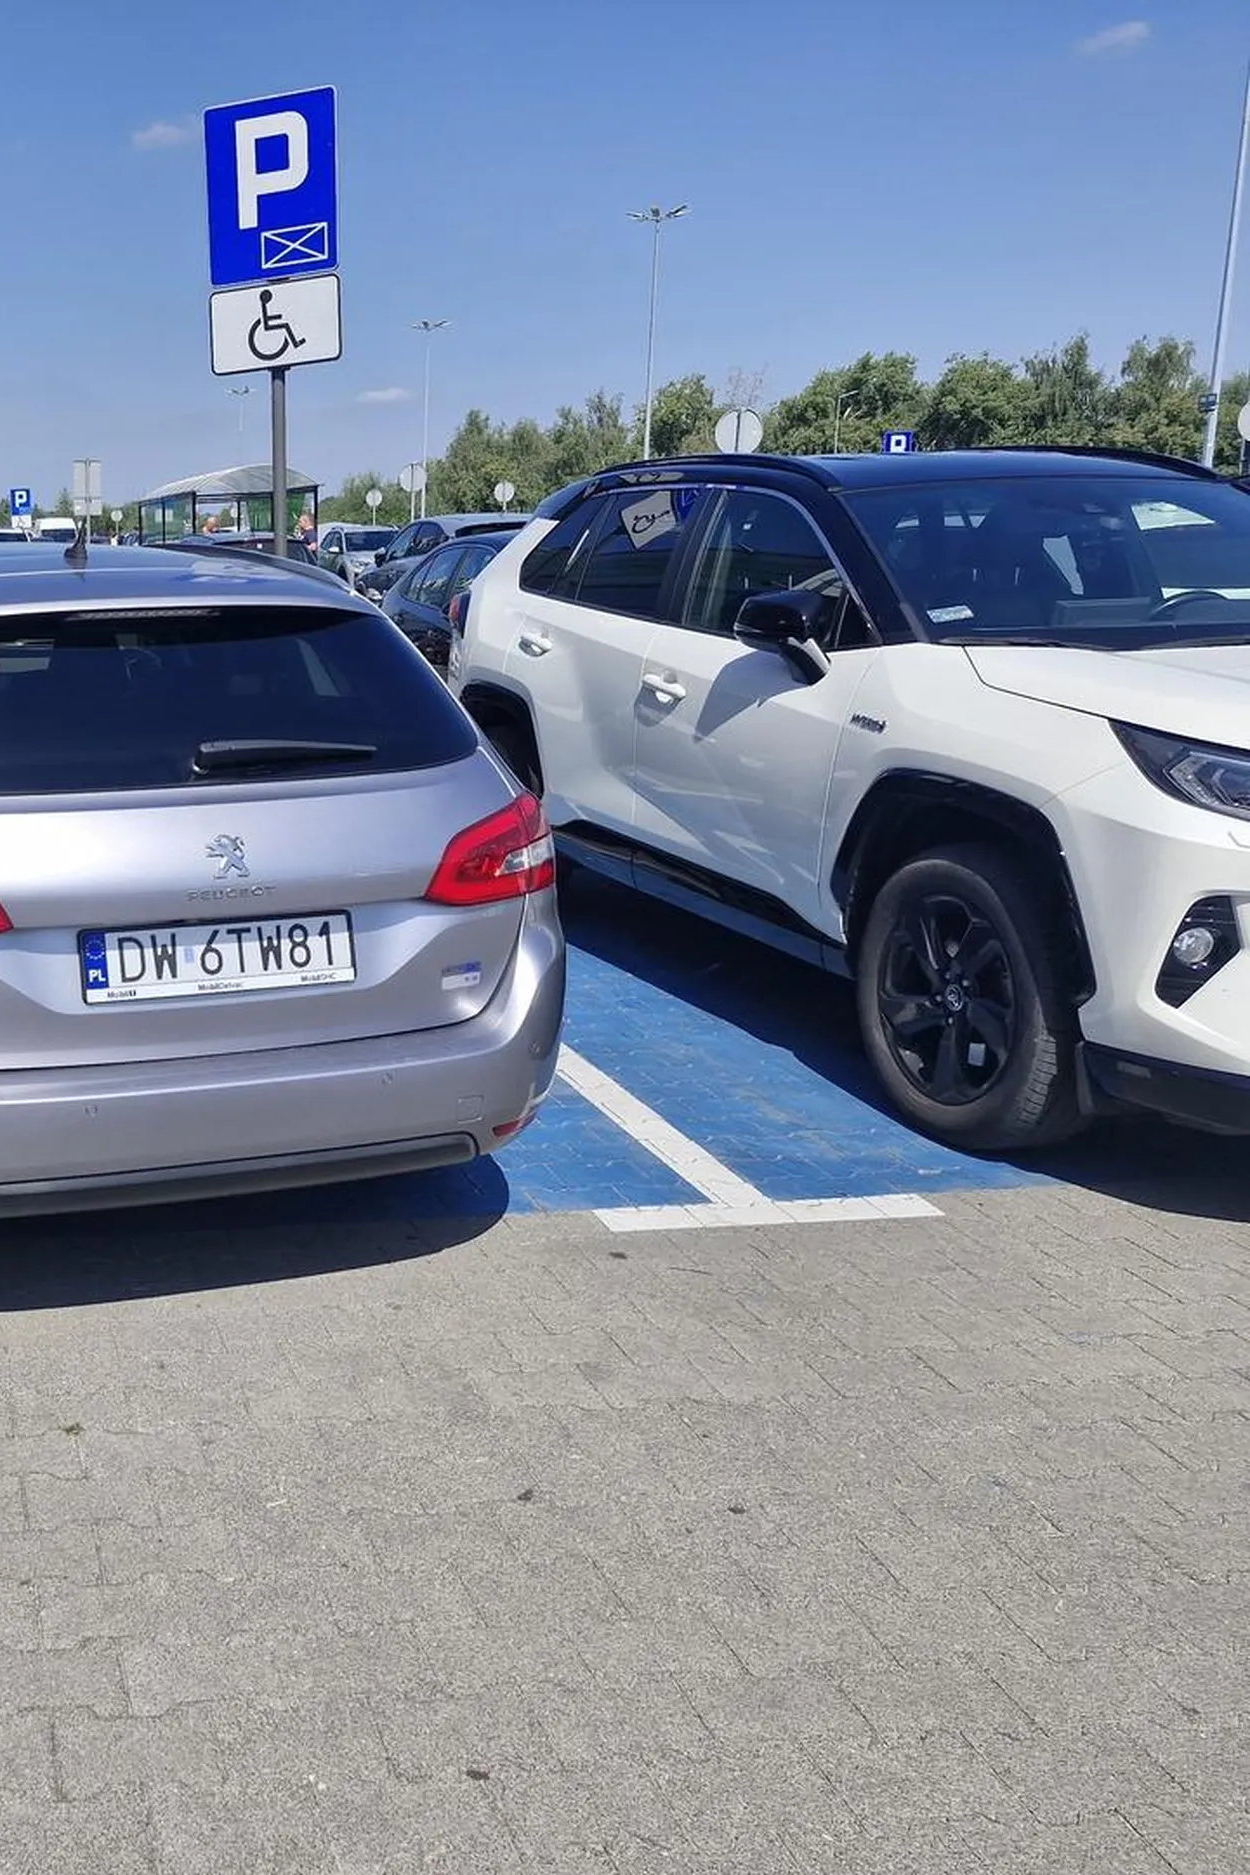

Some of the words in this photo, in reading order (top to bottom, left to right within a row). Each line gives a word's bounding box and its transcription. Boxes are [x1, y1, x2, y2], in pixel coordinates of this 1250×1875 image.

[235, 111, 309, 230] P
[15, 490, 27, 508] P
[188, 885, 276, 901] PEUGEOT
[89, 969, 106, 982] PL
[118, 933, 178, 983] DW
[200, 921, 334, 975] 6TW81
